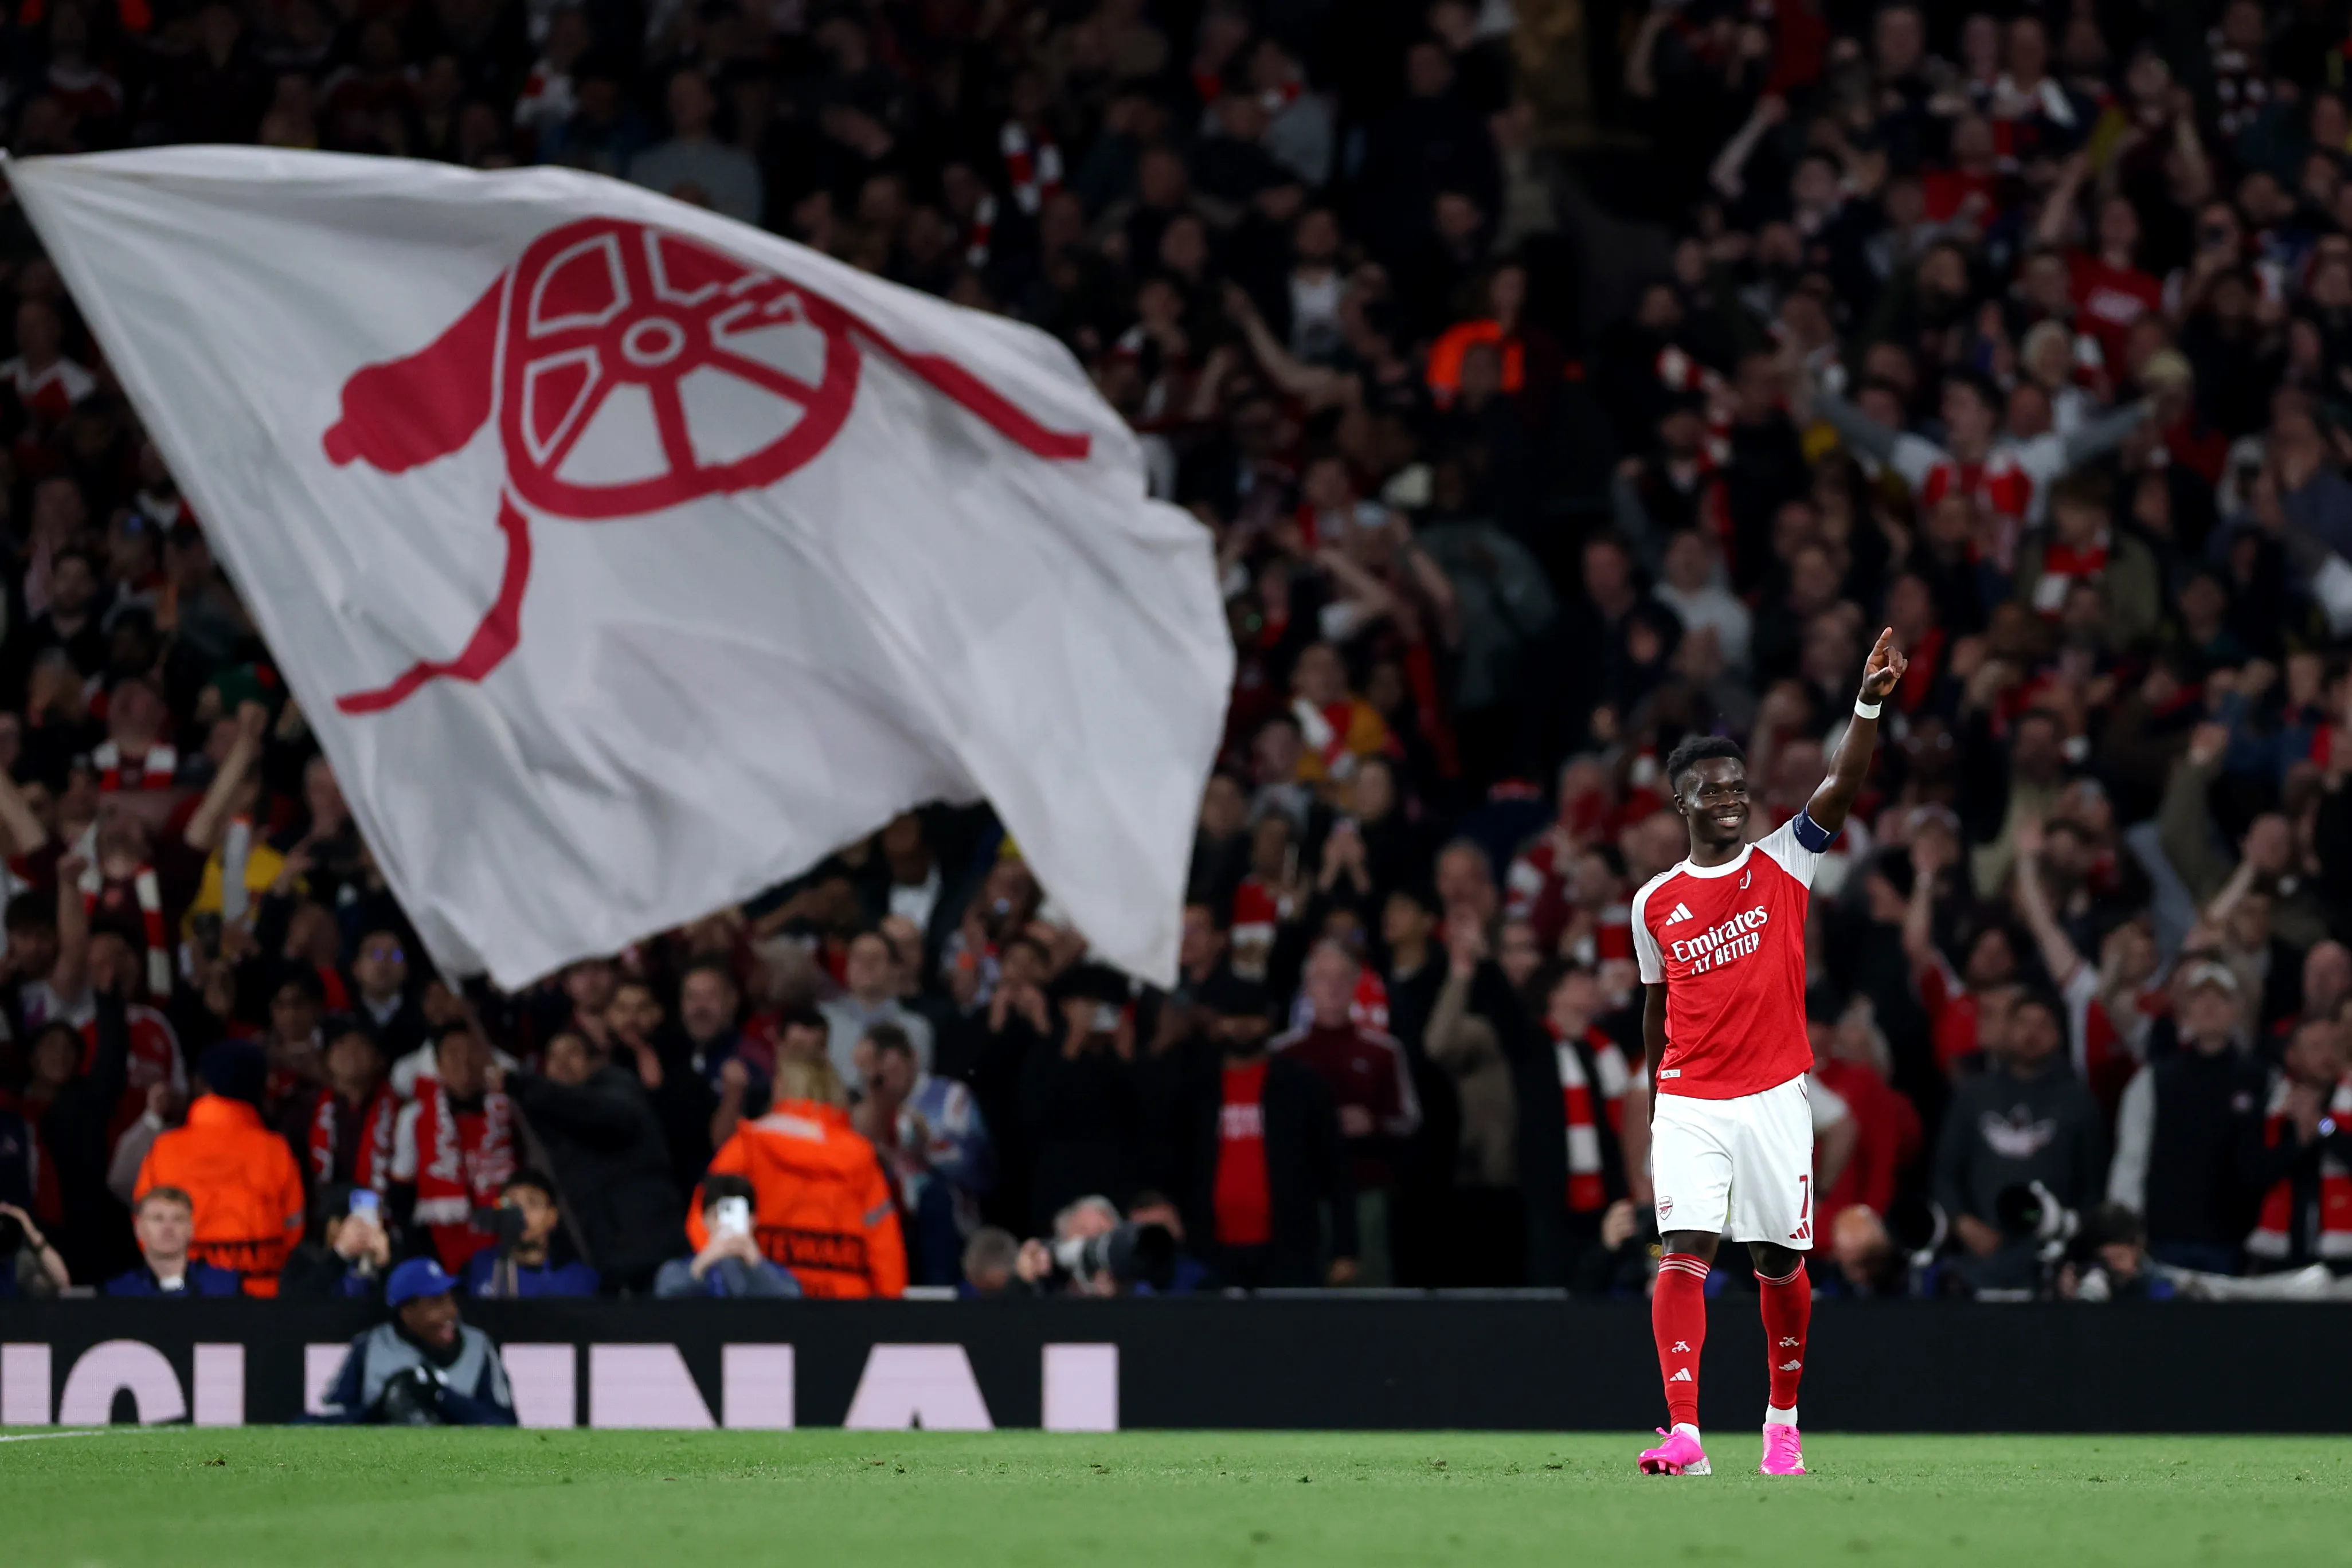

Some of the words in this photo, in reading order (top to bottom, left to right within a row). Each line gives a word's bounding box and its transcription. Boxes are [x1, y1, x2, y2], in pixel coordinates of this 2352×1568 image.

[1671, 905, 1768, 962] Emirates
[1715, 932, 1759, 966] BETTER
[1799, 1174, 1809, 1220] 7
